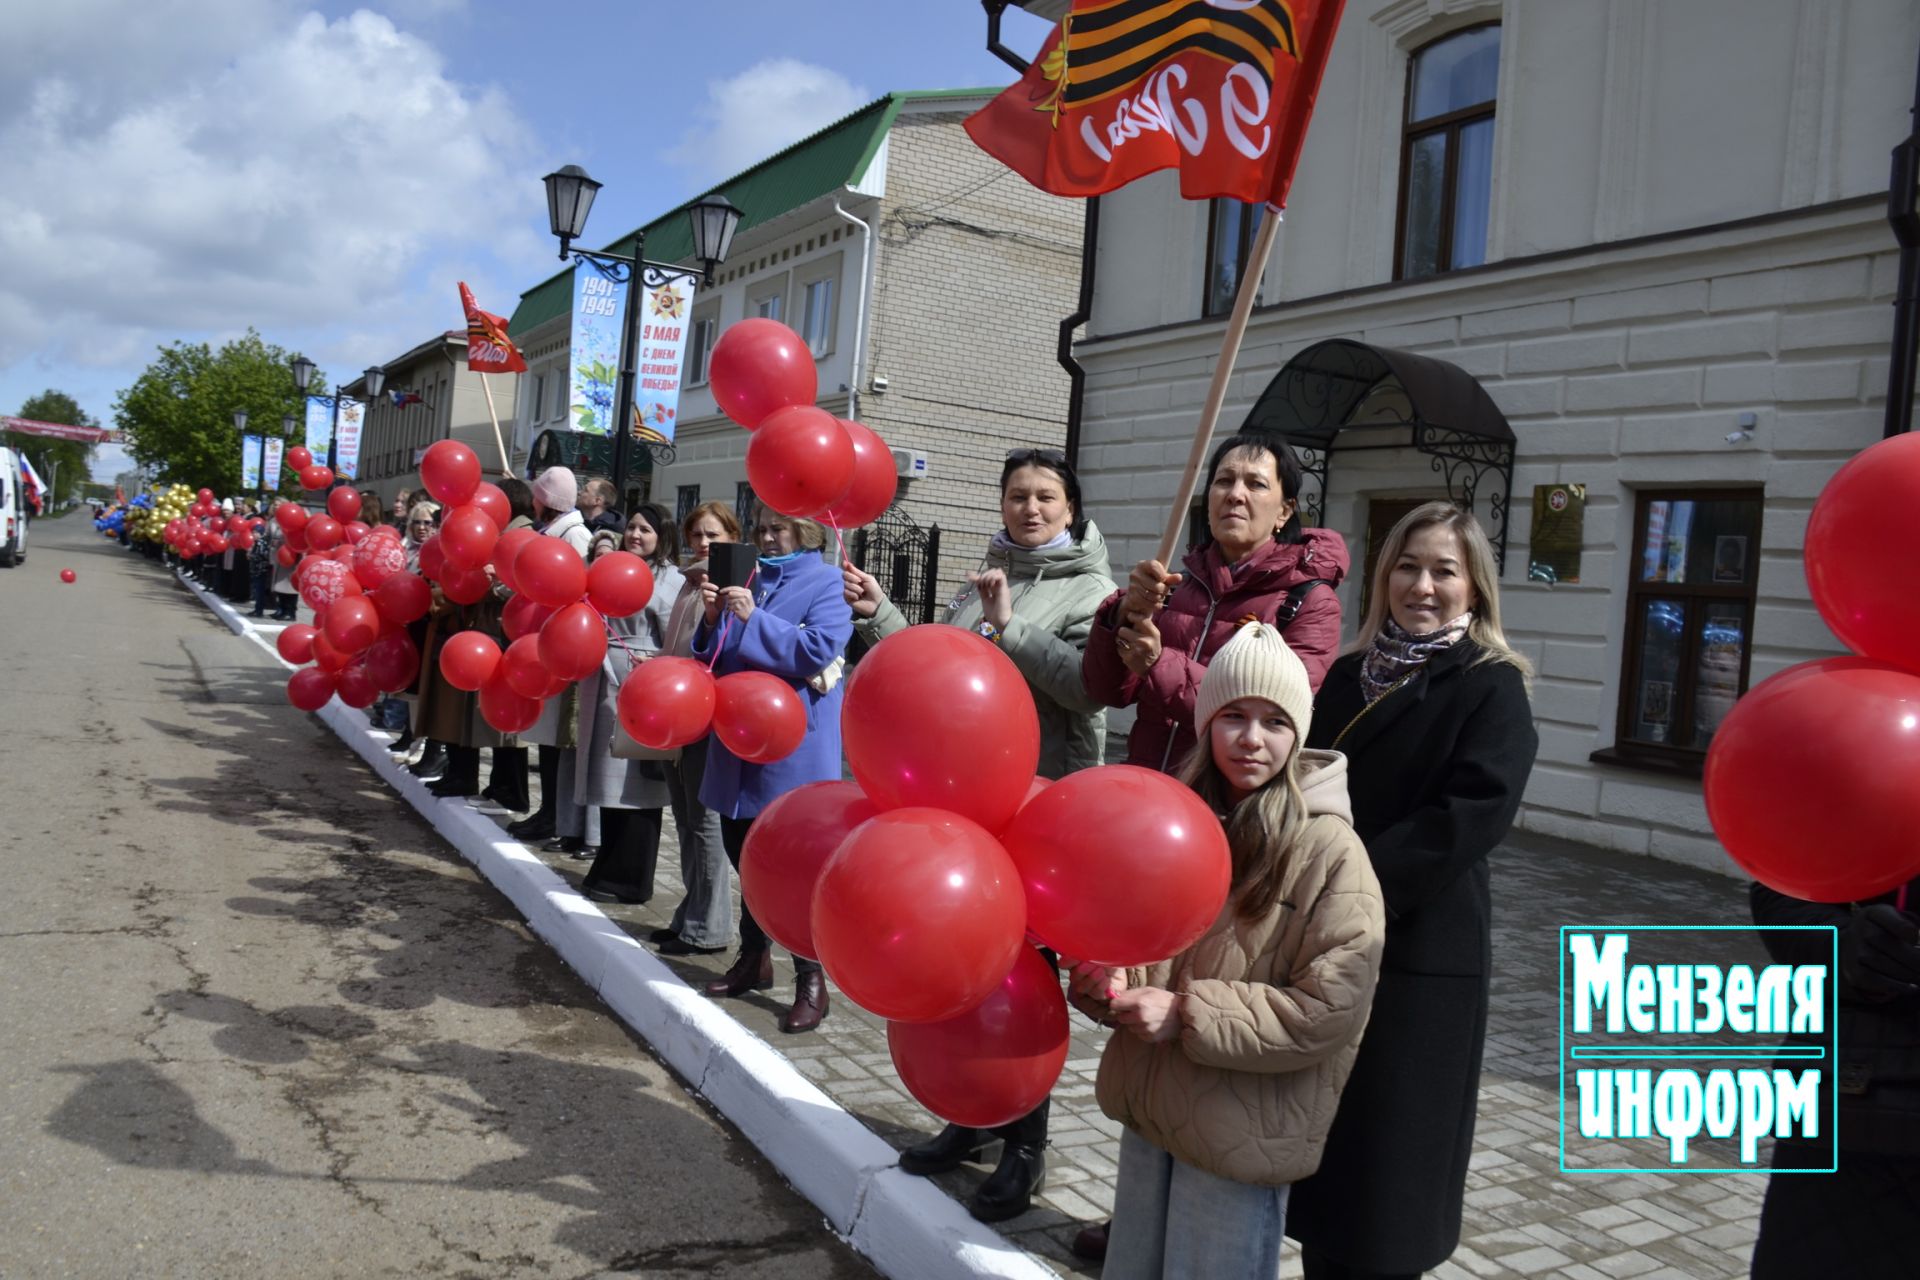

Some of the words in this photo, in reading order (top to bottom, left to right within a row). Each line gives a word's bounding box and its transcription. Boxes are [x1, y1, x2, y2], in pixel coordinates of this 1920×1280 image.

[580, 295, 616, 316] 1945
[643, 325, 651, 340] 9
[653, 326, 681, 342] МАЯ
